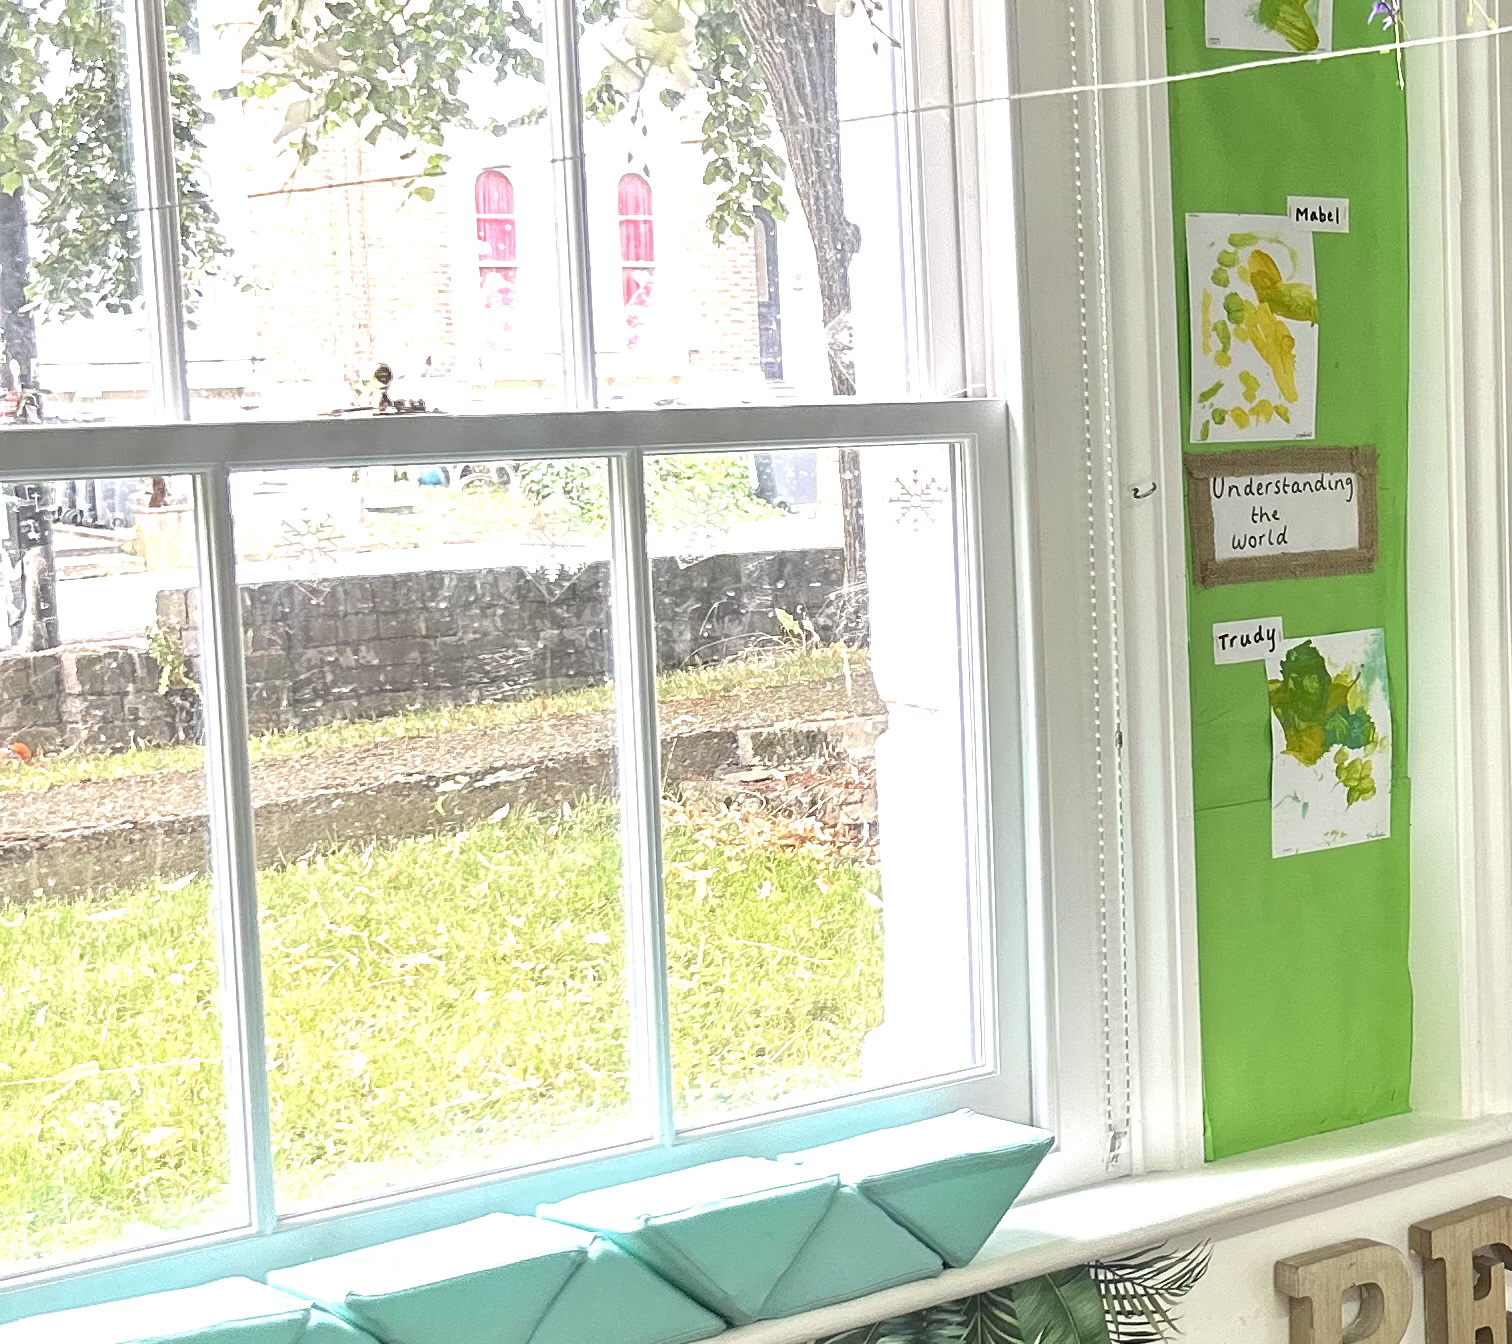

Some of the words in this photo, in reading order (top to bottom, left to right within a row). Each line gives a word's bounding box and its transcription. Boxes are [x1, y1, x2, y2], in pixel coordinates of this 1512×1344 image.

[1295, 205, 1340, 225] Mabel
[1212, 472, 1355, 503] Understanding
[1251, 505, 1281, 524] the
[1217, 625, 1276, 653] Trudy
